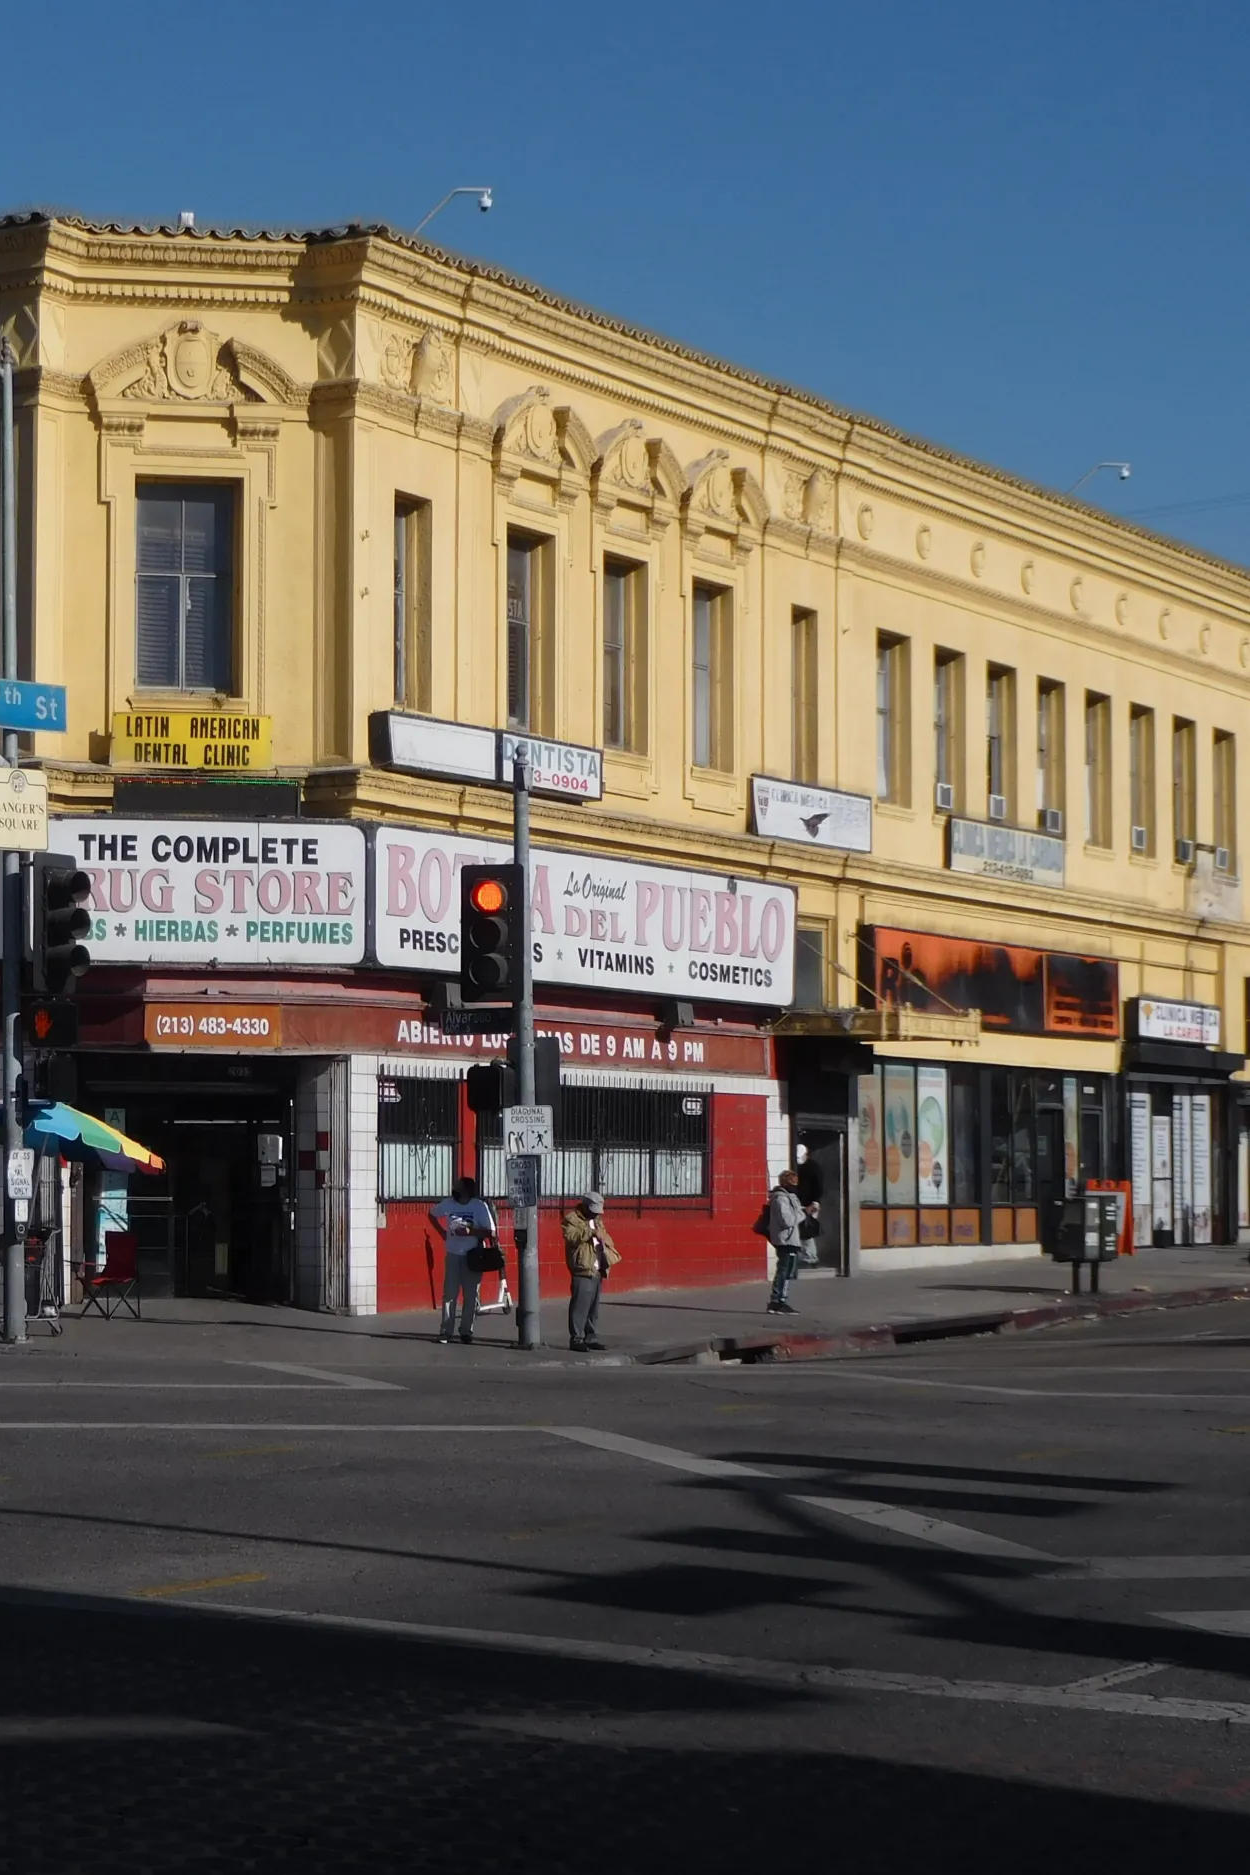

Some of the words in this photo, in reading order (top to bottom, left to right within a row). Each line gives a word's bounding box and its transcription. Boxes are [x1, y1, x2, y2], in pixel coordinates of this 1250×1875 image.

[35, 696, 58, 721] St
[126, 716, 170, 738] LATIN
[190, 718, 260, 740] AMERICAN
[134, 743, 189, 765] DENTAL
[203, 745, 250, 767] CLINIC
[78, 834, 138, 861] THE
[151, 836, 319, 864] COMPLETE
[76, 868, 175, 913] RUG
[194, 868, 356, 916] STORE
[386, 843, 556, 935] BOA
[581, 874, 627, 904] Original
[134, 919, 219, 943] HIERBAS
[245, 920, 353, 945] PERFUMES
[564, 904, 627, 944] DEL
[634, 879, 786, 964] PUEBLO
[577, 947, 655, 976] VITAMINS
[688, 960, 773, 989] COSMETICS
[156, 1014, 194, 1036] (213)
[198, 1014, 269, 1036] 483-4330
[580, 1035, 601, 1056] DE
[607, 1036, 616, 1056] 9
[623, 1037, 646, 1059] AM
[651, 1042, 662, 1060] A
[668, 1042, 677, 1061] 9
[684, 1043, 704, 1063] PM
[510, 1108, 544, 1116] DIAGONAL
[510, 1116, 545, 1124] CROSSING
[12, 1152, 31, 1160] CRSS
[511, 1161, 531, 1169] CROSS
[14, 1188, 28, 1196] ONLY
[510, 1187, 531, 1195] SIGNAL
